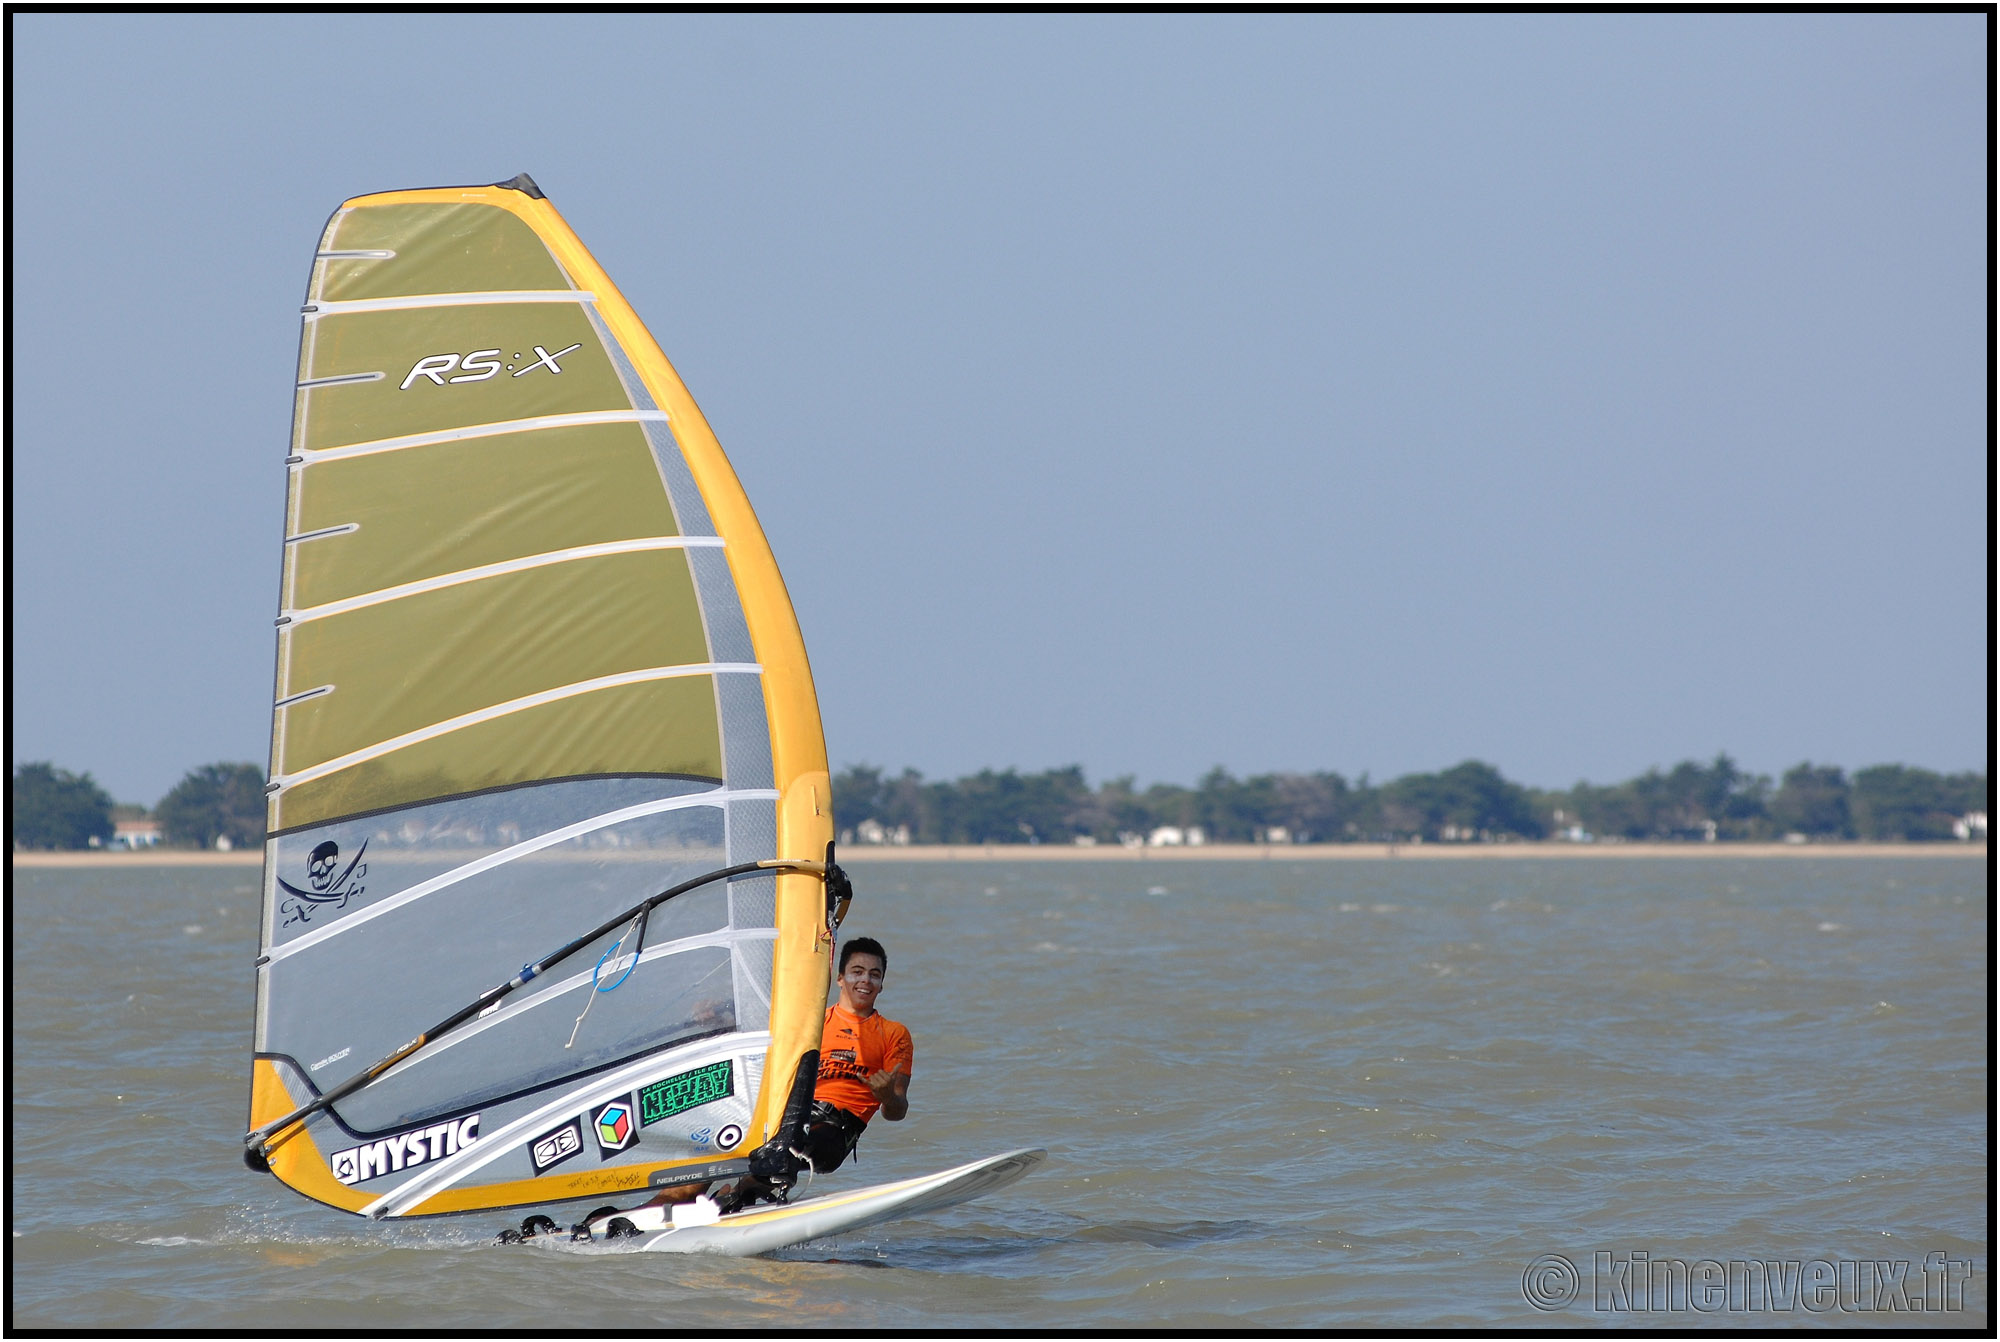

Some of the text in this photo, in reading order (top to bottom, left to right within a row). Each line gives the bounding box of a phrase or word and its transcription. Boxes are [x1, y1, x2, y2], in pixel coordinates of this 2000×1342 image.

[399, 343, 582, 390] RS:X
[642, 1068, 729, 1119] NEWAY
[652, 1073, 686, 1089] ROCHELLE
[359, 1113, 481, 1180] MYSTIC
[656, 1172, 703, 1185] NEILPRYDE
